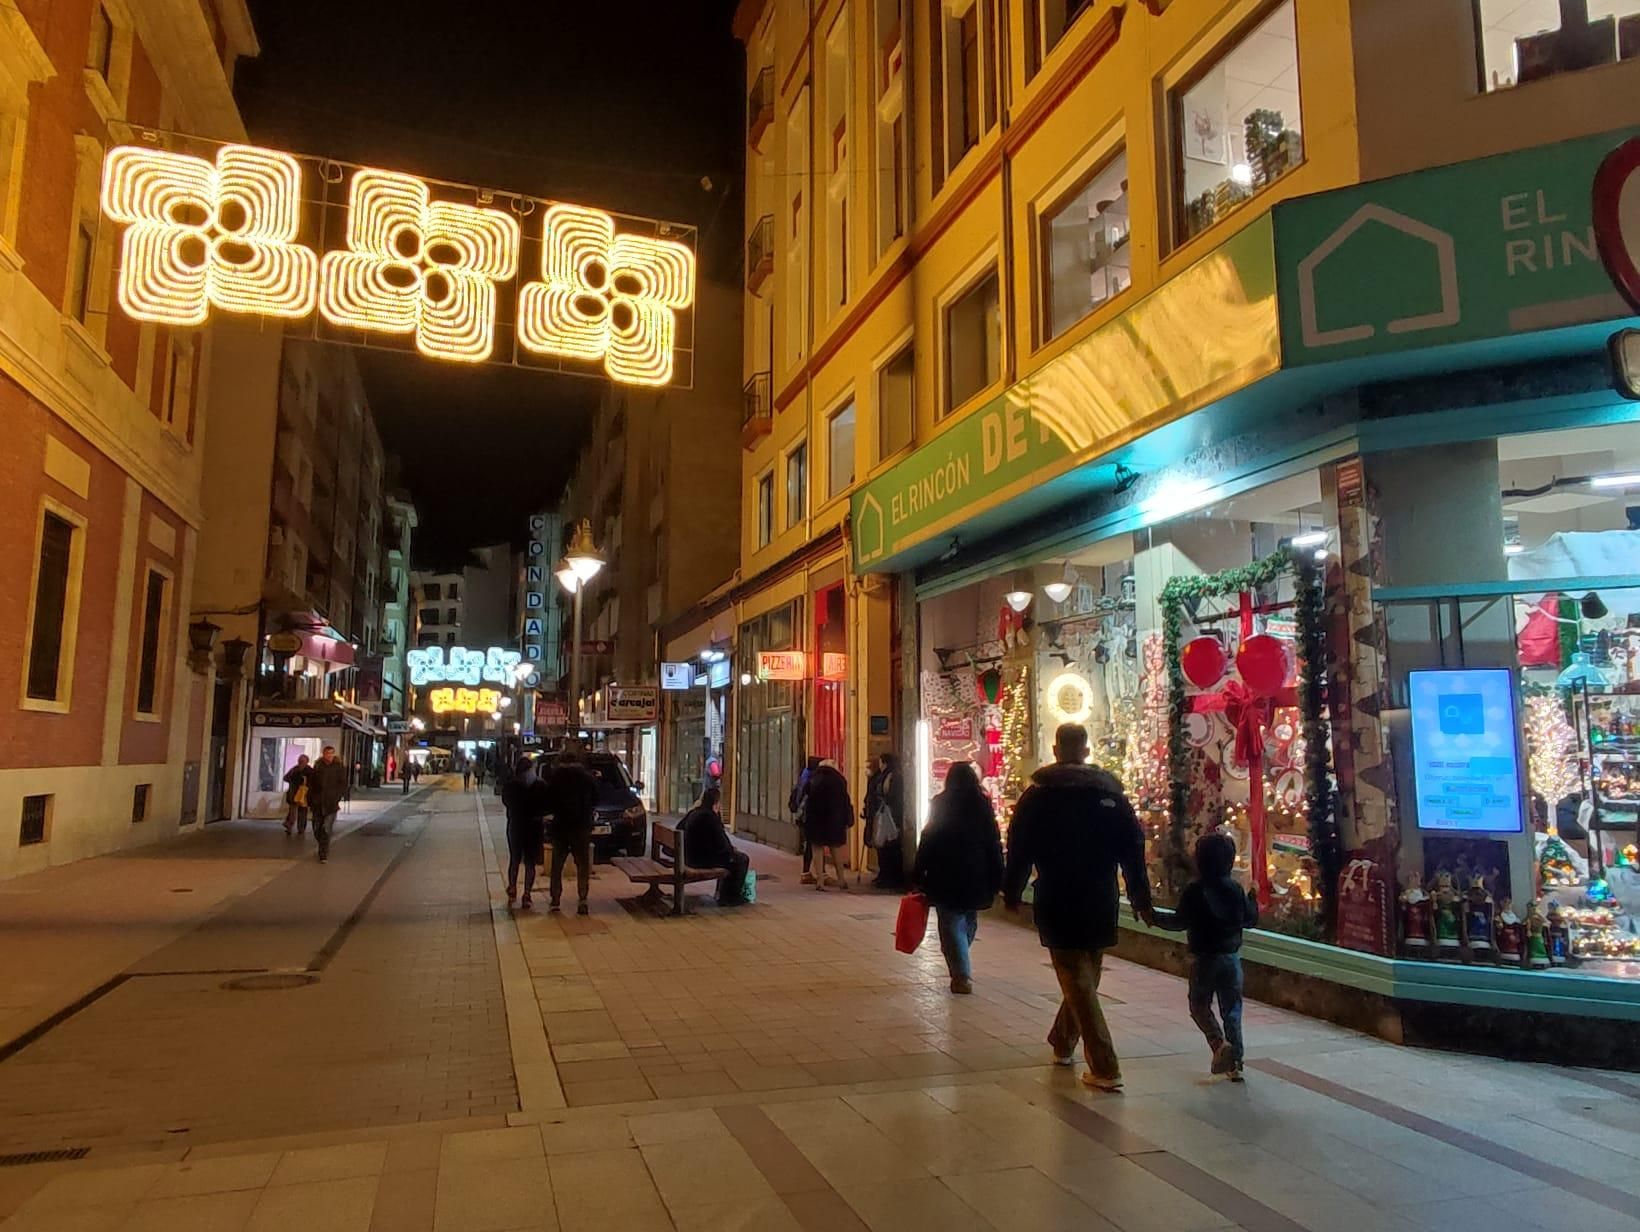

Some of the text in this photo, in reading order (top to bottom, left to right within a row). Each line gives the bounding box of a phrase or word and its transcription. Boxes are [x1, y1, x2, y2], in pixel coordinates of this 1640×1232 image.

[1502, 189, 1567, 230] EL
[1506, 226, 1598, 276] RIN
[891, 491, 908, 525] EL
[909, 451, 970, 515] RINCÓN
[982, 400, 1028, 475] DE
[526, 516, 544, 687] CONDADO
